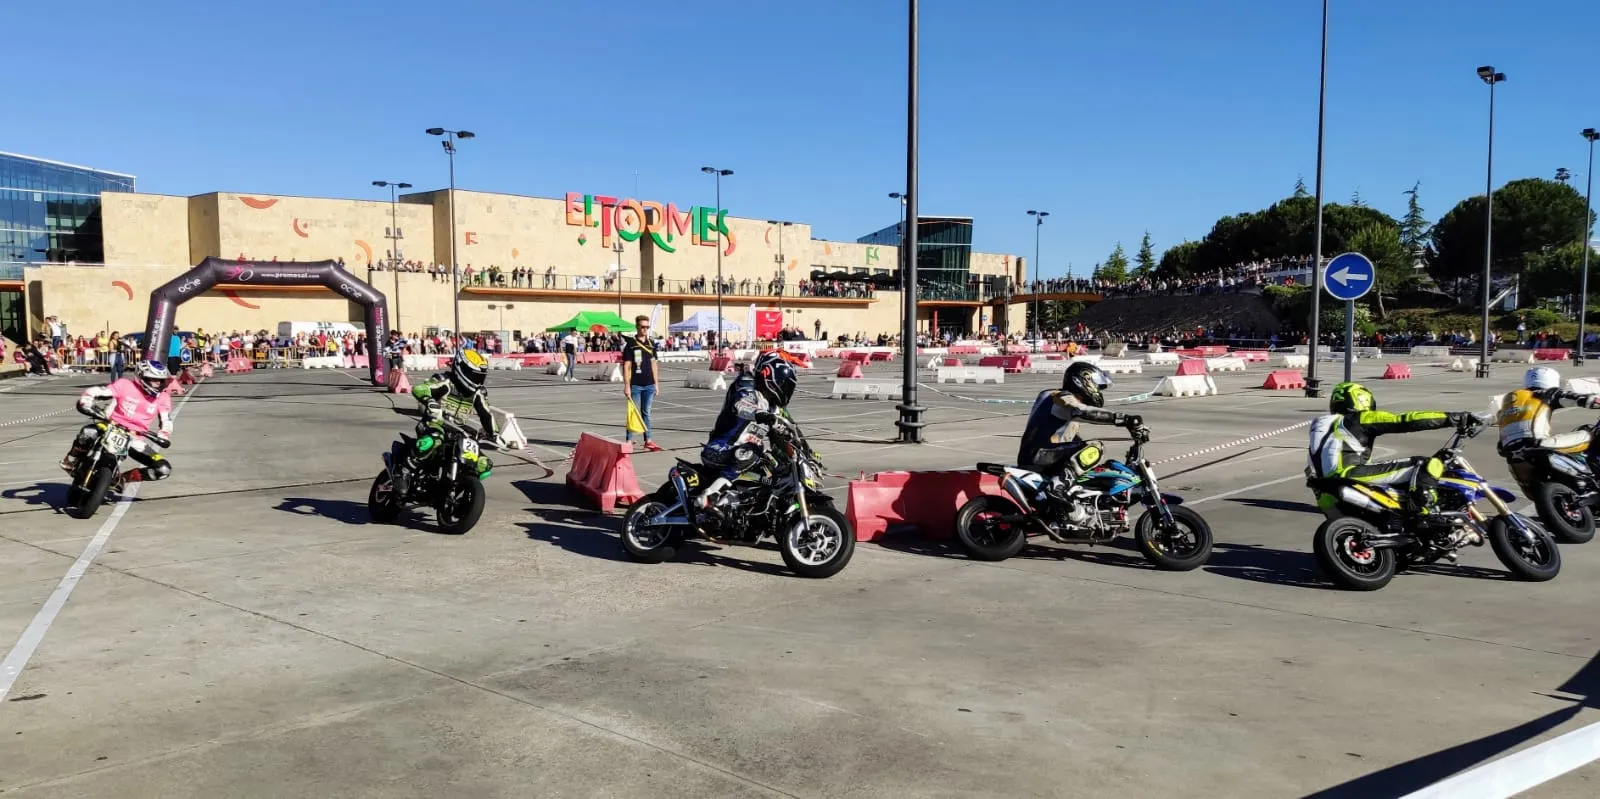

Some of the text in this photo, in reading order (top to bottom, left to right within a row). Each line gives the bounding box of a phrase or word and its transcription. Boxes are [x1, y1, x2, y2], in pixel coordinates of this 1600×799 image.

[566, 192, 736, 256] EL TORMES
[110, 435, 124, 447] 40
[686, 473, 699, 487] 37
